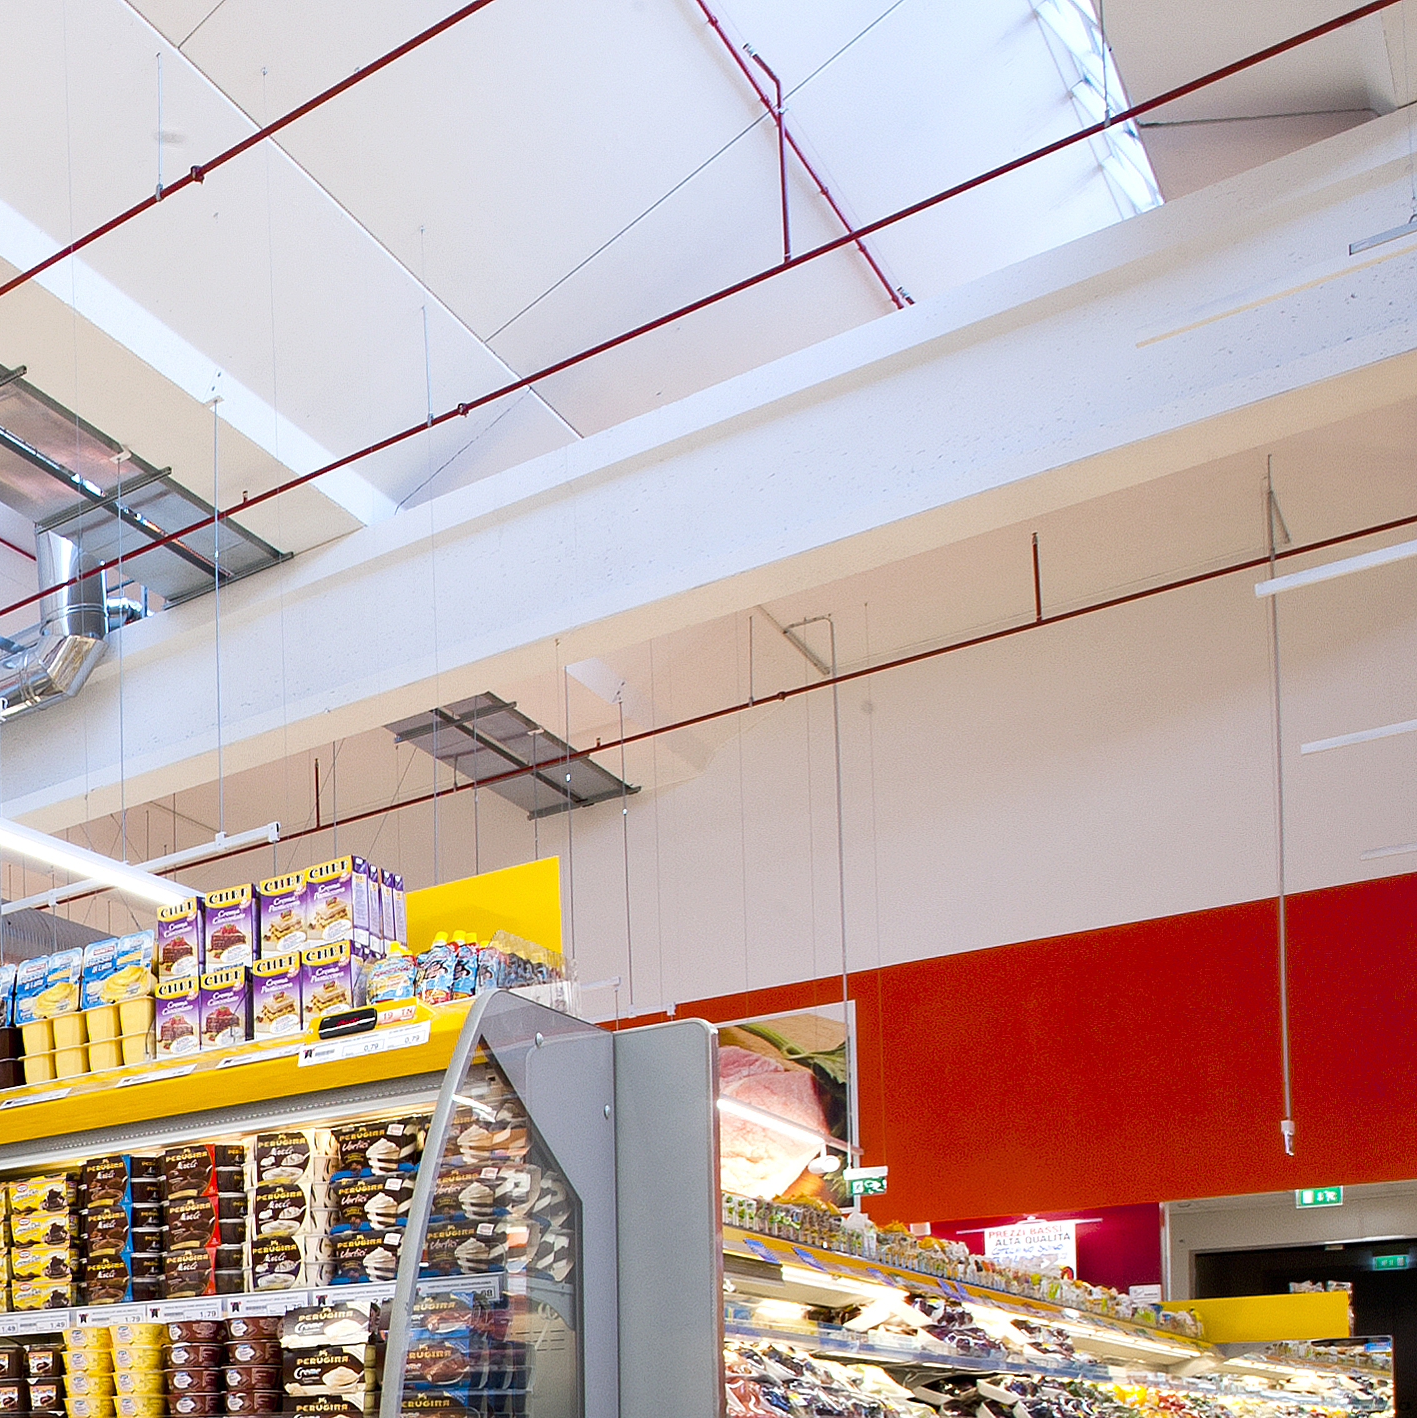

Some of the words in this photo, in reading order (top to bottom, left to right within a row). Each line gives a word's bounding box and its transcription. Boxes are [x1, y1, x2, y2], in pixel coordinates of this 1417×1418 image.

[309, 860, 351, 881] CHEF
[264, 873, 304, 893] CHEF
[208, 886, 248, 907] CHEF
[160, 901, 193, 919] CHEF
[256, 954, 297, 974] CHEF
[203, 968, 242, 988] CHEF
[158, 980, 197, 997] CHEF
[166, 1151, 208, 1163] PERUGINA
[86, 1161, 124, 1173] PERUGINA
[169, 1203, 211, 1214] PERUGINA
[88, 1211, 125, 1222] PERUGINA
[988, 1229, 1026, 1240] PREZZI
[1029, 1225, 1063, 1236] BASSI
[995, 1237, 1022, 1247] ALTA
[166, 1253, 209, 1264] PERUGINA
[87, 1261, 125, 1272] PERUGINA
